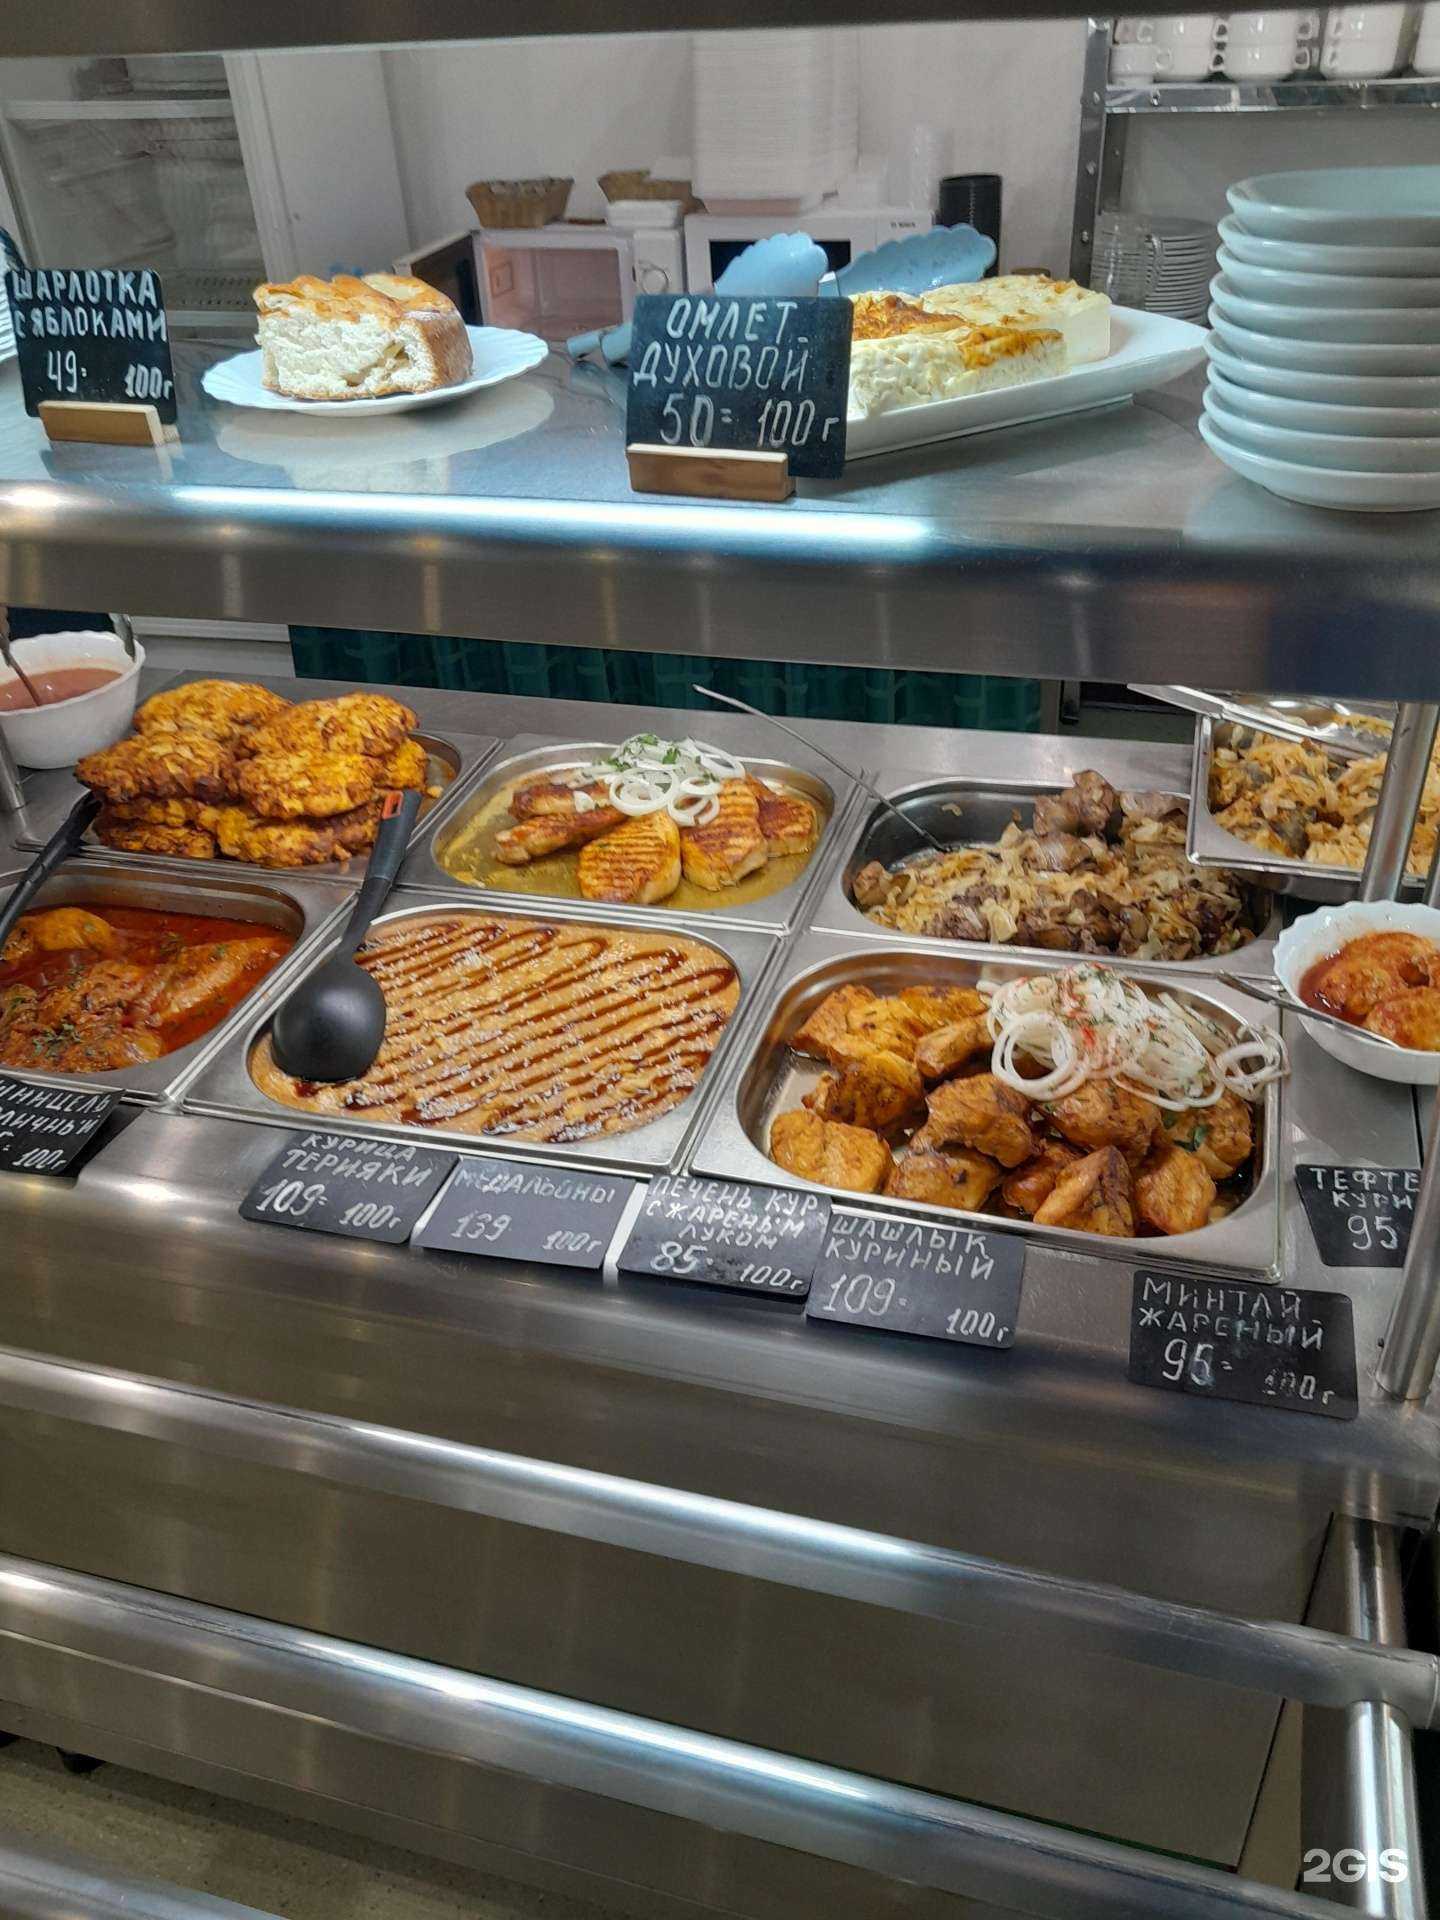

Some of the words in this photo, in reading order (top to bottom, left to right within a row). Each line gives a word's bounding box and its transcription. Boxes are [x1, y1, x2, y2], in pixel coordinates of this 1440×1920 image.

[11, 270, 158, 307] ШАРЛОТКА
[13, 306, 26, 339] С
[31, 305, 168, 343] ЯБЛОКАМИ
[666, 297, 798, 344] ОМЛЕТ
[632, 335, 809, 393] ДУХОВОЙ
[0, 1107, 101, 1136] ЛИЧНЫЙ
[301, 1133, 418, 1163] КУРИЦА
[282, 1149, 433, 1187] ТЕРИЯКИ
[650, 1175, 753, 1211] ПЕЧЕНЬ
[678, 1224, 778, 1251] ЛУКОМ
[832, 1215, 990, 1260] ШАШЛЫК
[1347, 1215, 1398, 1250] 95
[824, 1236, 995, 1281] КУРИНЫЙ
[1138, 1307, 1324, 1350] ЖАРЕНЫЙ
